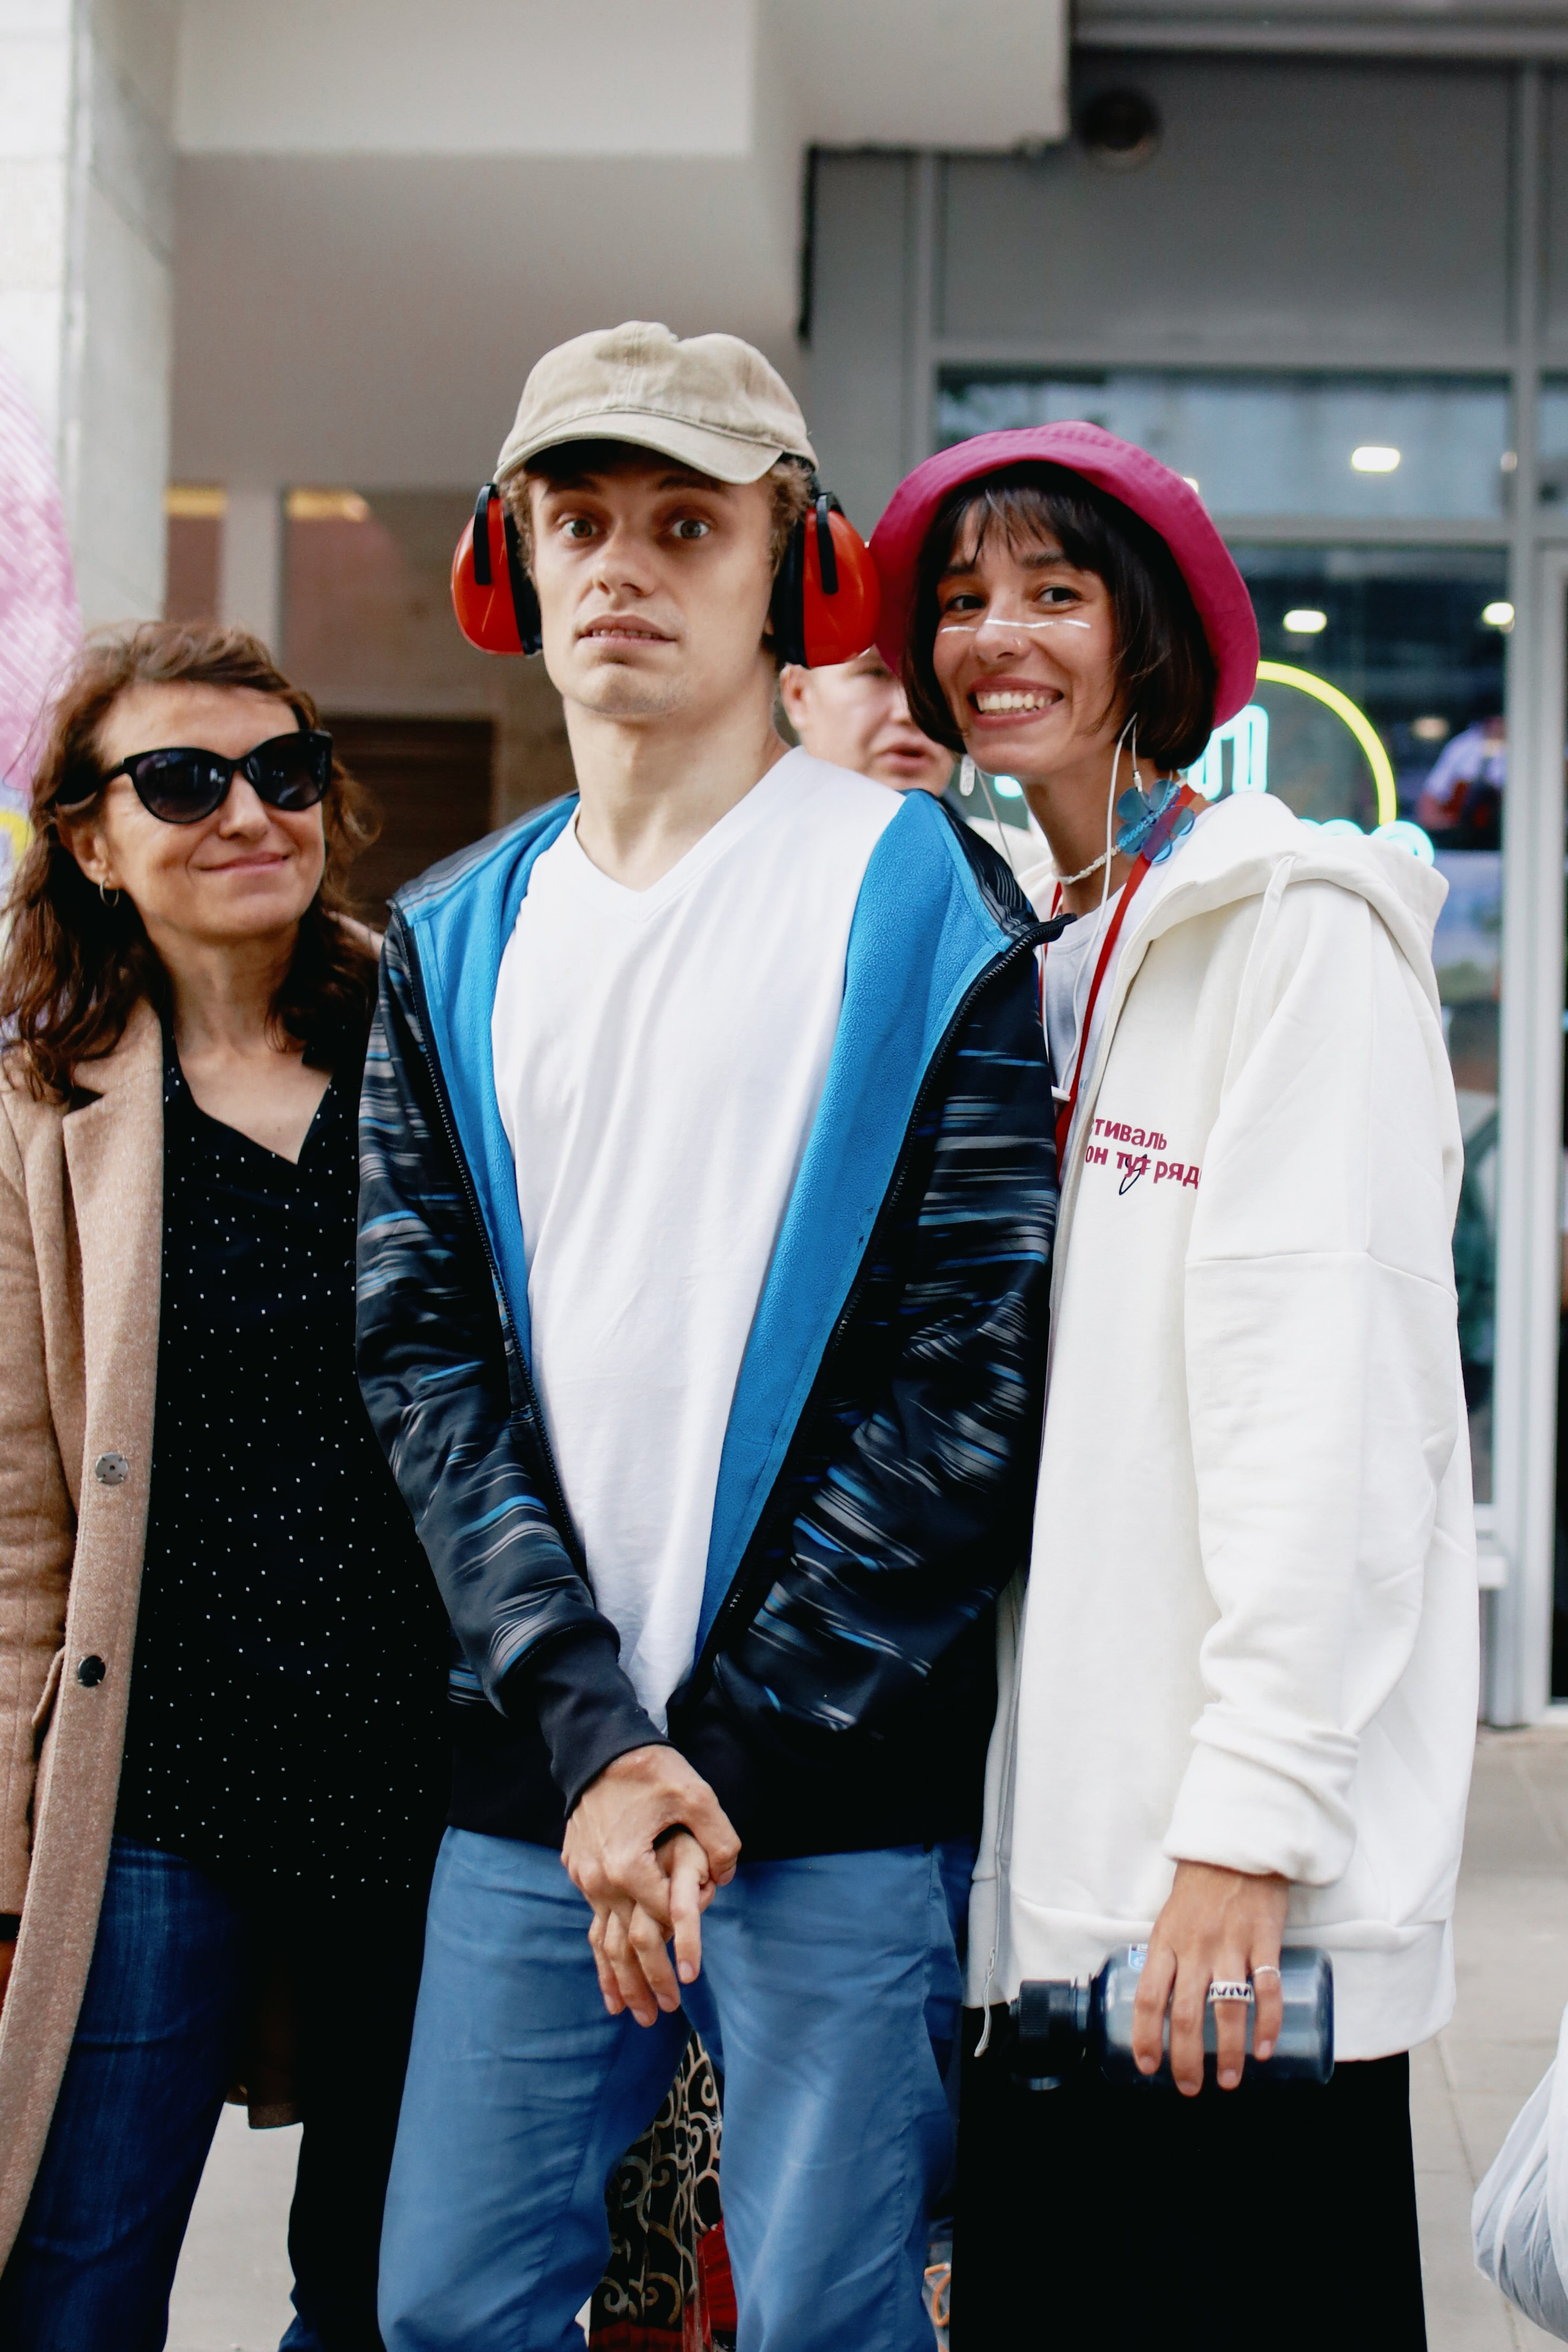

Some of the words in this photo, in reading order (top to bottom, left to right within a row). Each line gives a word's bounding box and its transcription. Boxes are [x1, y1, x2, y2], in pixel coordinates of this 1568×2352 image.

[1092, 1118, 1167, 1150] тиваль
[1117, 1151, 1152, 1178] тут
[1153, 1161, 1202, 1189] ряд
